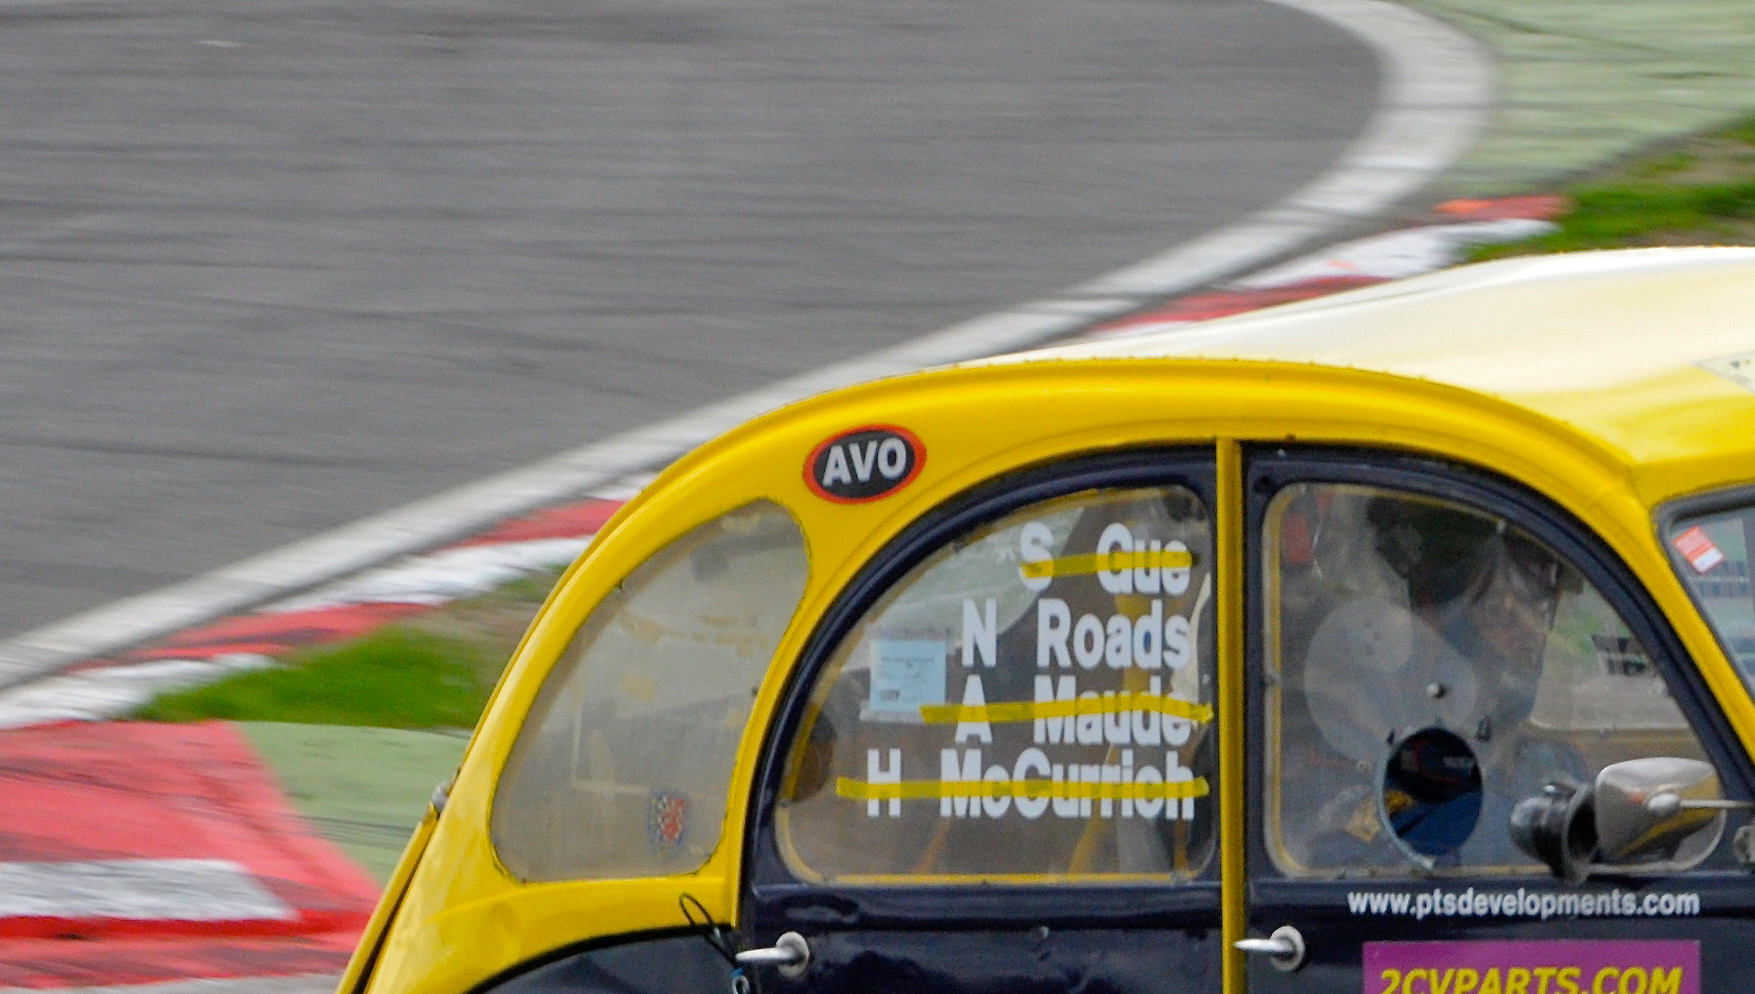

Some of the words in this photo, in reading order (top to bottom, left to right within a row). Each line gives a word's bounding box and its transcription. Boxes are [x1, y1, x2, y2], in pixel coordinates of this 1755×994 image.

[822, 437, 907, 487] AVO
[1019, 521, 1054, 591] S
[962, 598, 998, 668] N
[1036, 598, 1192, 669] Roads
[954, 674, 993, 744] A
[1033, 674, 1192, 746] Maude
[866, 748, 901, 817] H
[1348, 887, 1700, 921] www.ptsdevelopments.com
